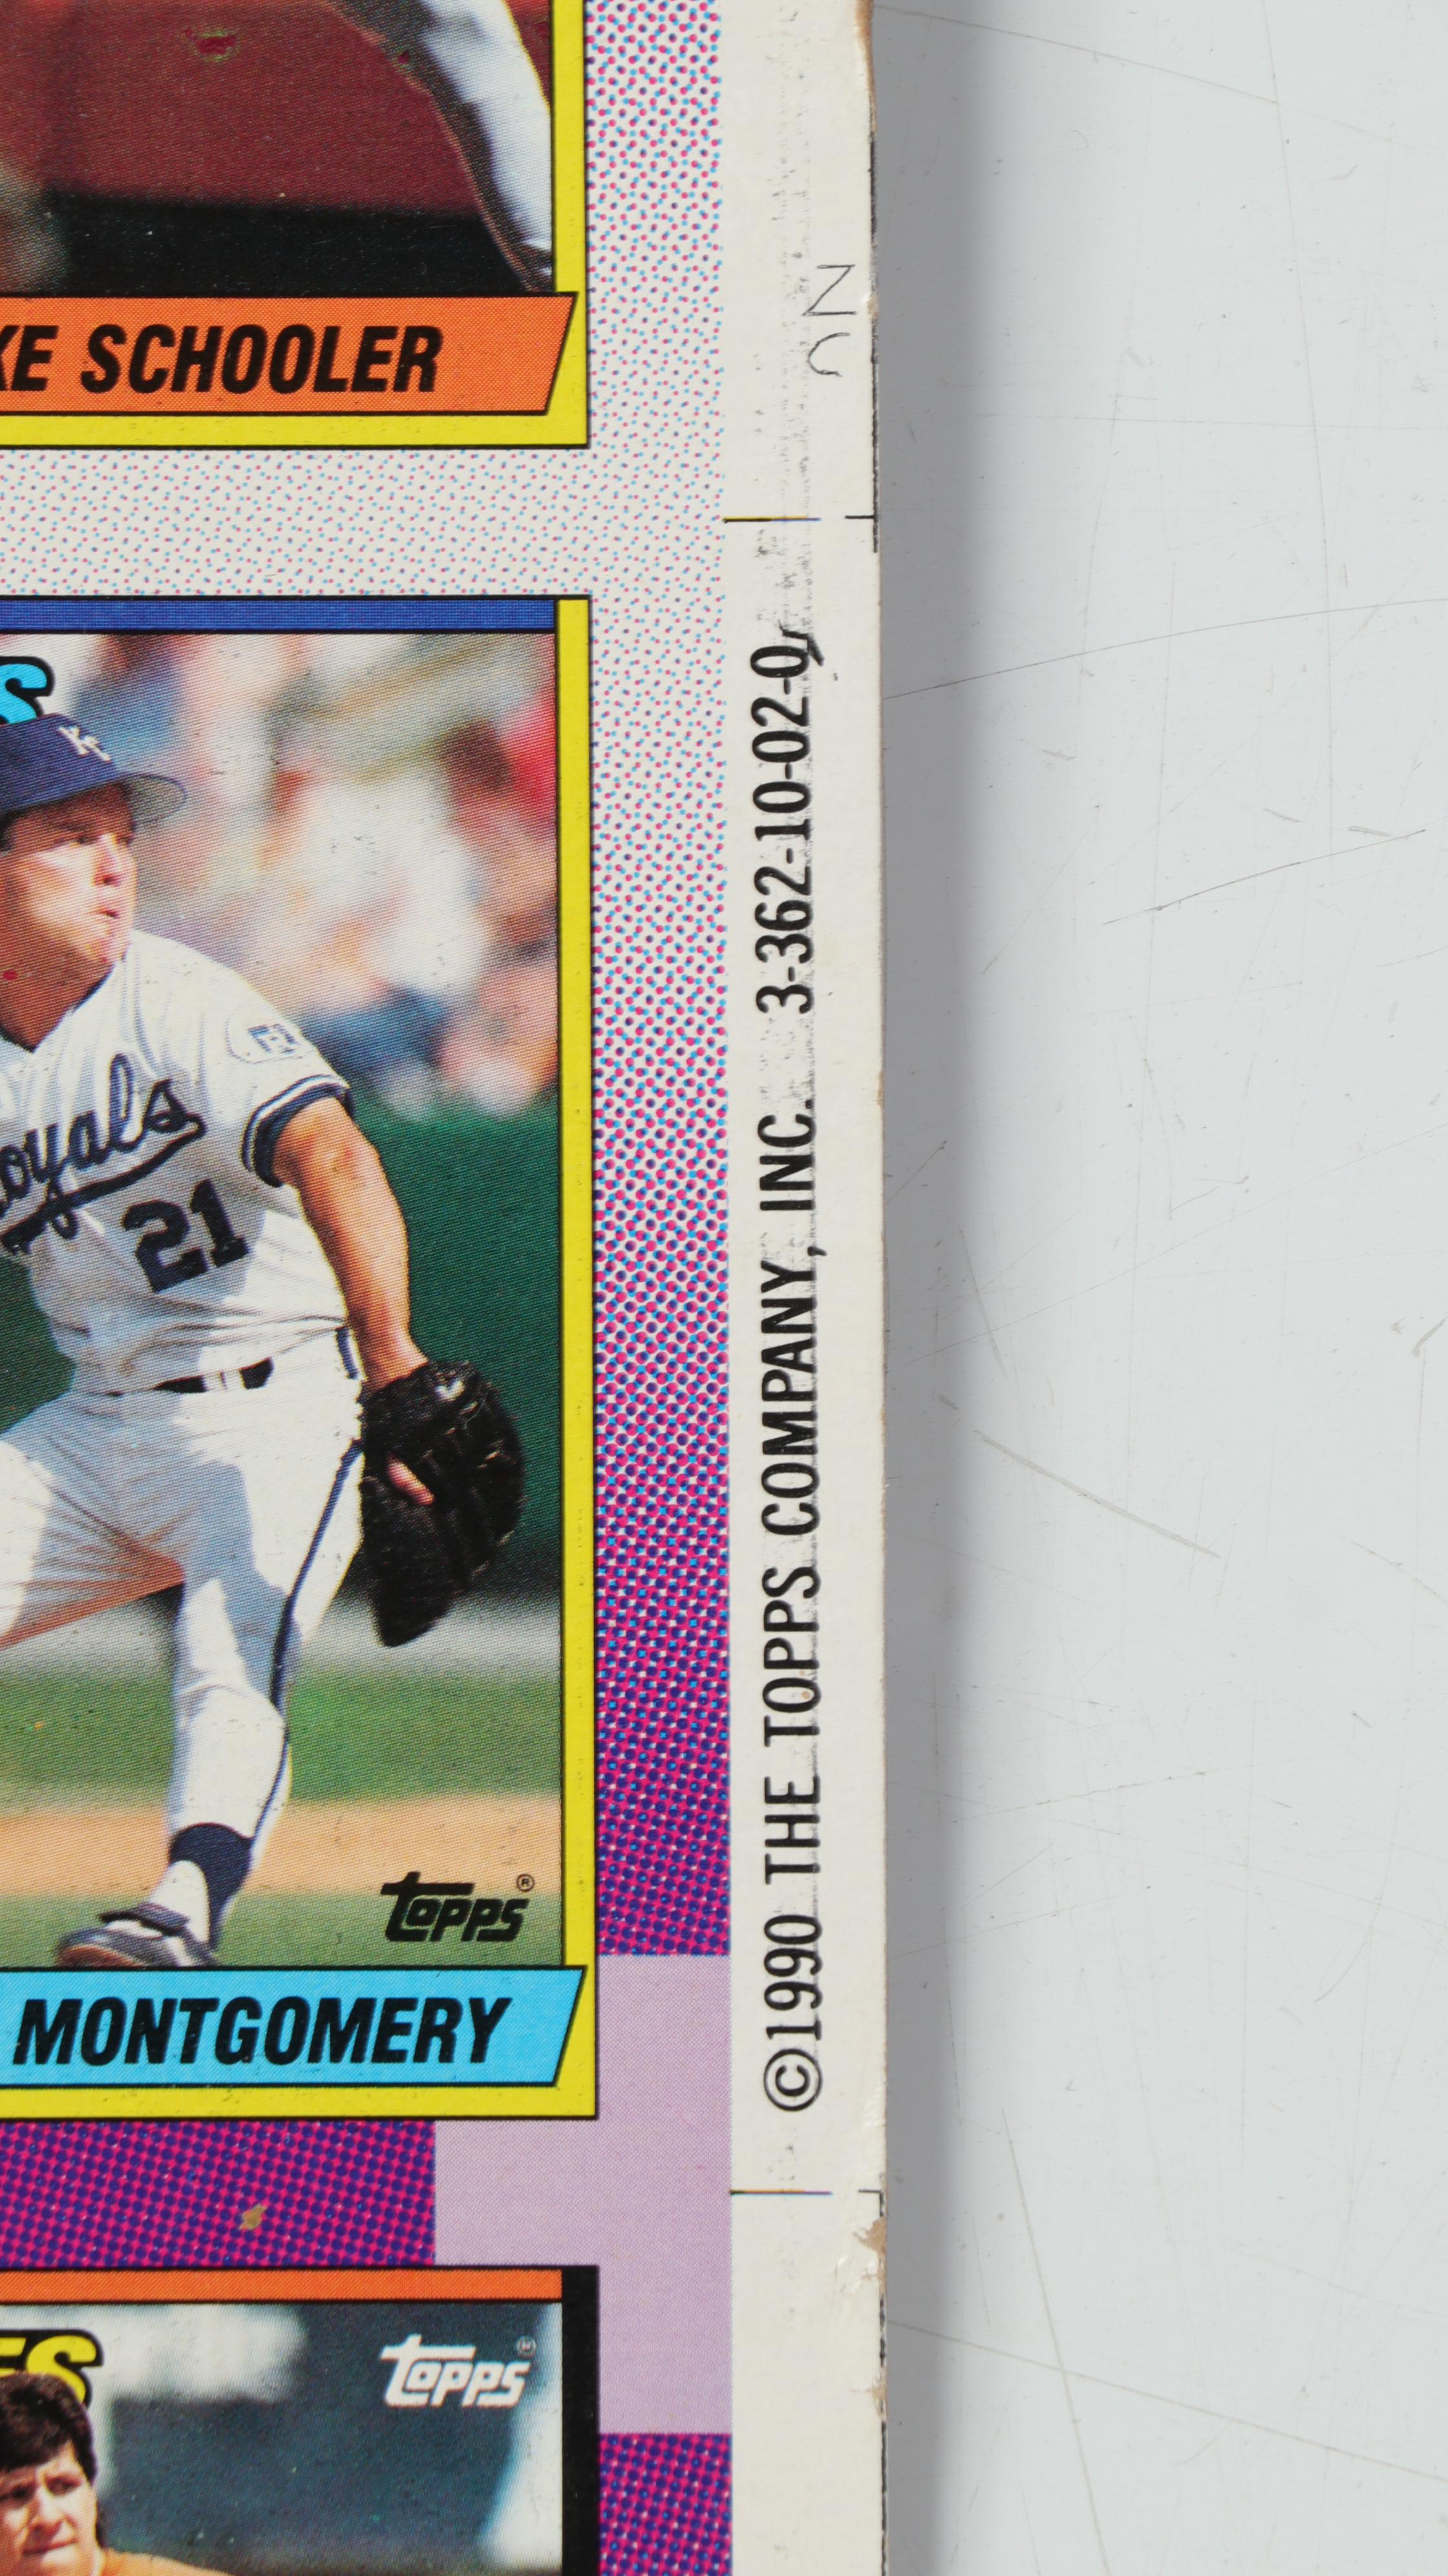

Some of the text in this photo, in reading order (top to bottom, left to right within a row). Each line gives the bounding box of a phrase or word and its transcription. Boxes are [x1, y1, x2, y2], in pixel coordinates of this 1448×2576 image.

[81, 325, 443, 394] SCHOOLER
[0, 1053, 207, 1240] oyals
[757, 1099, 815, 1211] INC.
[123, 1179, 250, 1293] 21
[760, 1246, 827, 1536] COMPANY,
[761, 1566, 821, 1746] TOPPS
[763, 1776, 820, 1884] THE
[14, 1997, 511, 2066] MONTGOMERY
